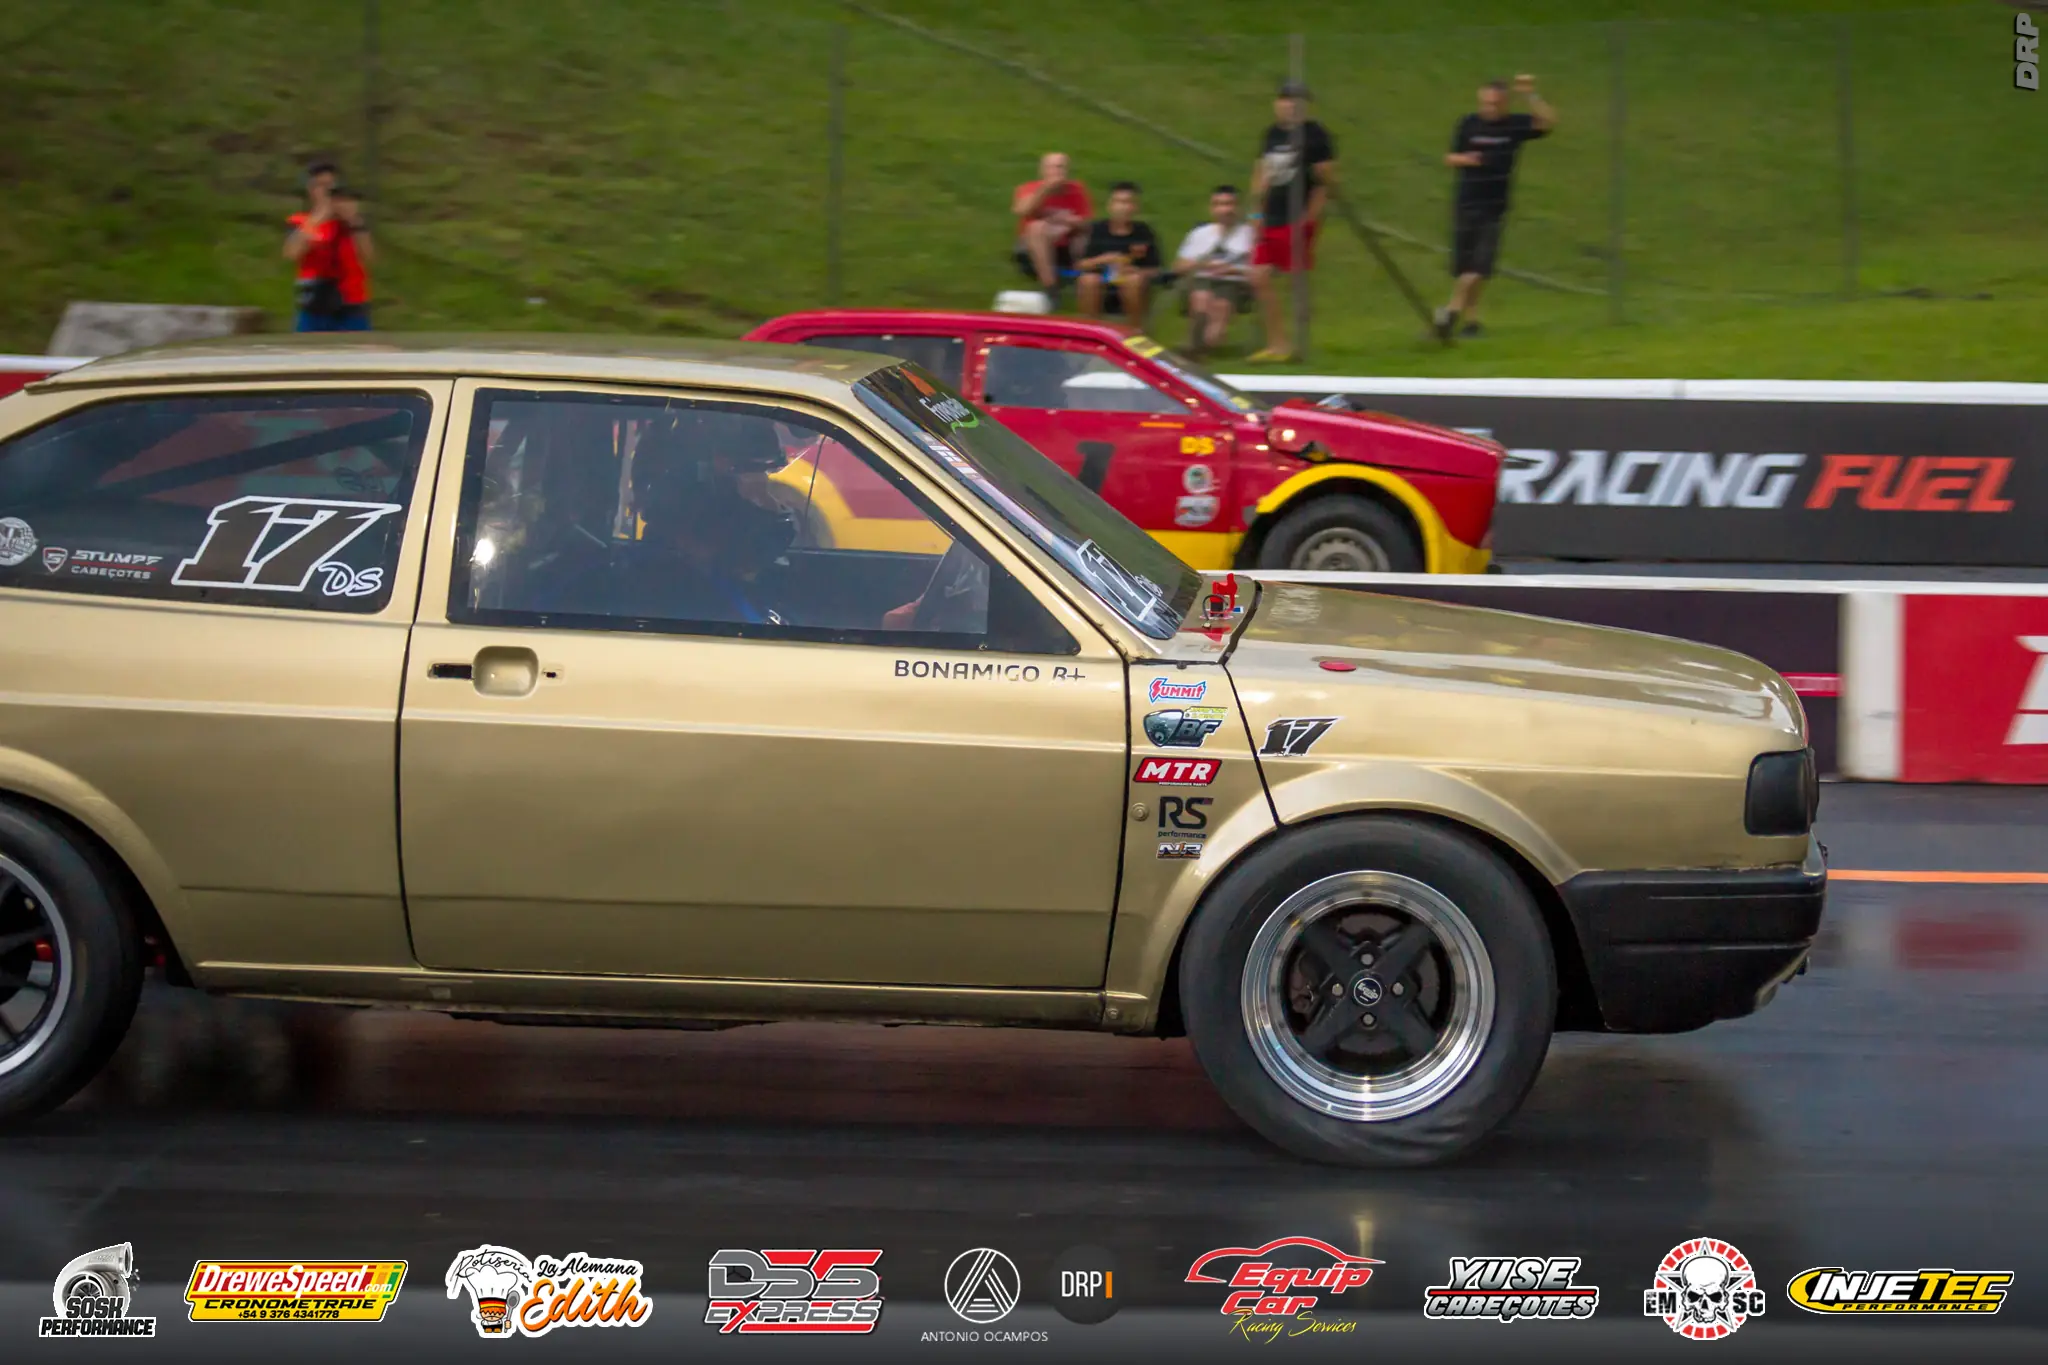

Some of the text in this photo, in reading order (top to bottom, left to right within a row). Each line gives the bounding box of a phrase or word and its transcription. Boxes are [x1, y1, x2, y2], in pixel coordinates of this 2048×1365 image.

[1501, 449, 2016, 513] RACING FUEL
[171, 495, 402, 592] 17
[71, 549, 163, 565] STUMPF
[71, 565, 152, 580] CABEÇOTES
[894, 659, 1040, 683] BONAMIGO
[1256, 716, 1342, 757] 17
[1141, 761, 1212, 781] MTR
[1158, 796, 1215, 830] RS
[1157, 830, 1207, 840] performance
